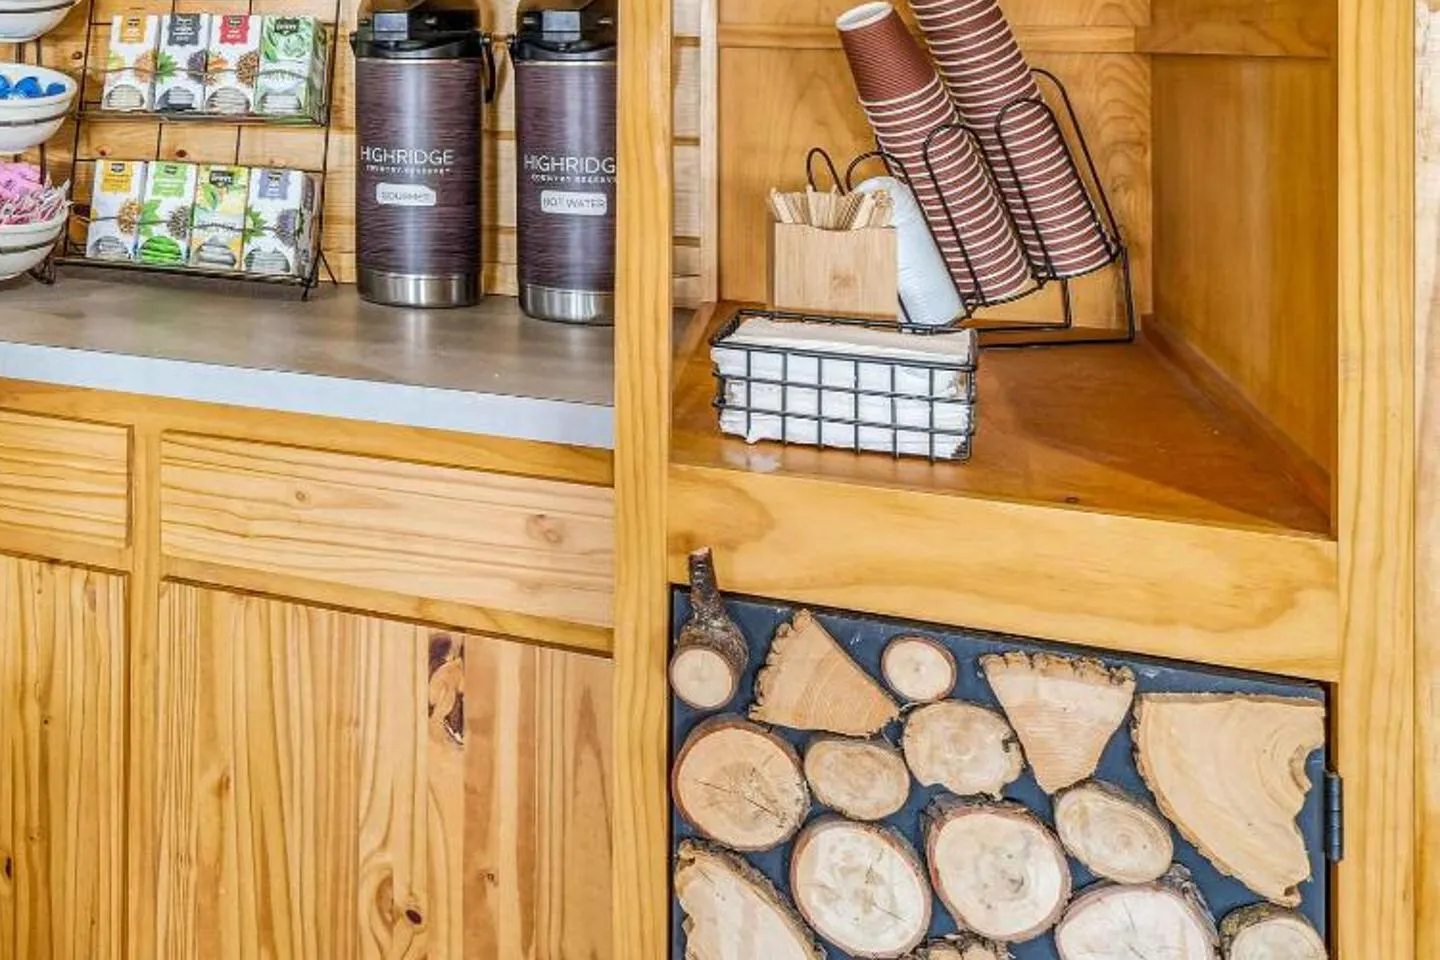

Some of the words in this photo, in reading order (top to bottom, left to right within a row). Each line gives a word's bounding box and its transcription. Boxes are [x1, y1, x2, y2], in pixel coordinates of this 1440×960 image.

[360, 145, 456, 166] HIGHRIDGE
[523, 154, 617, 174] HIGHRIDG
[566, 199, 606, 209] WATER
